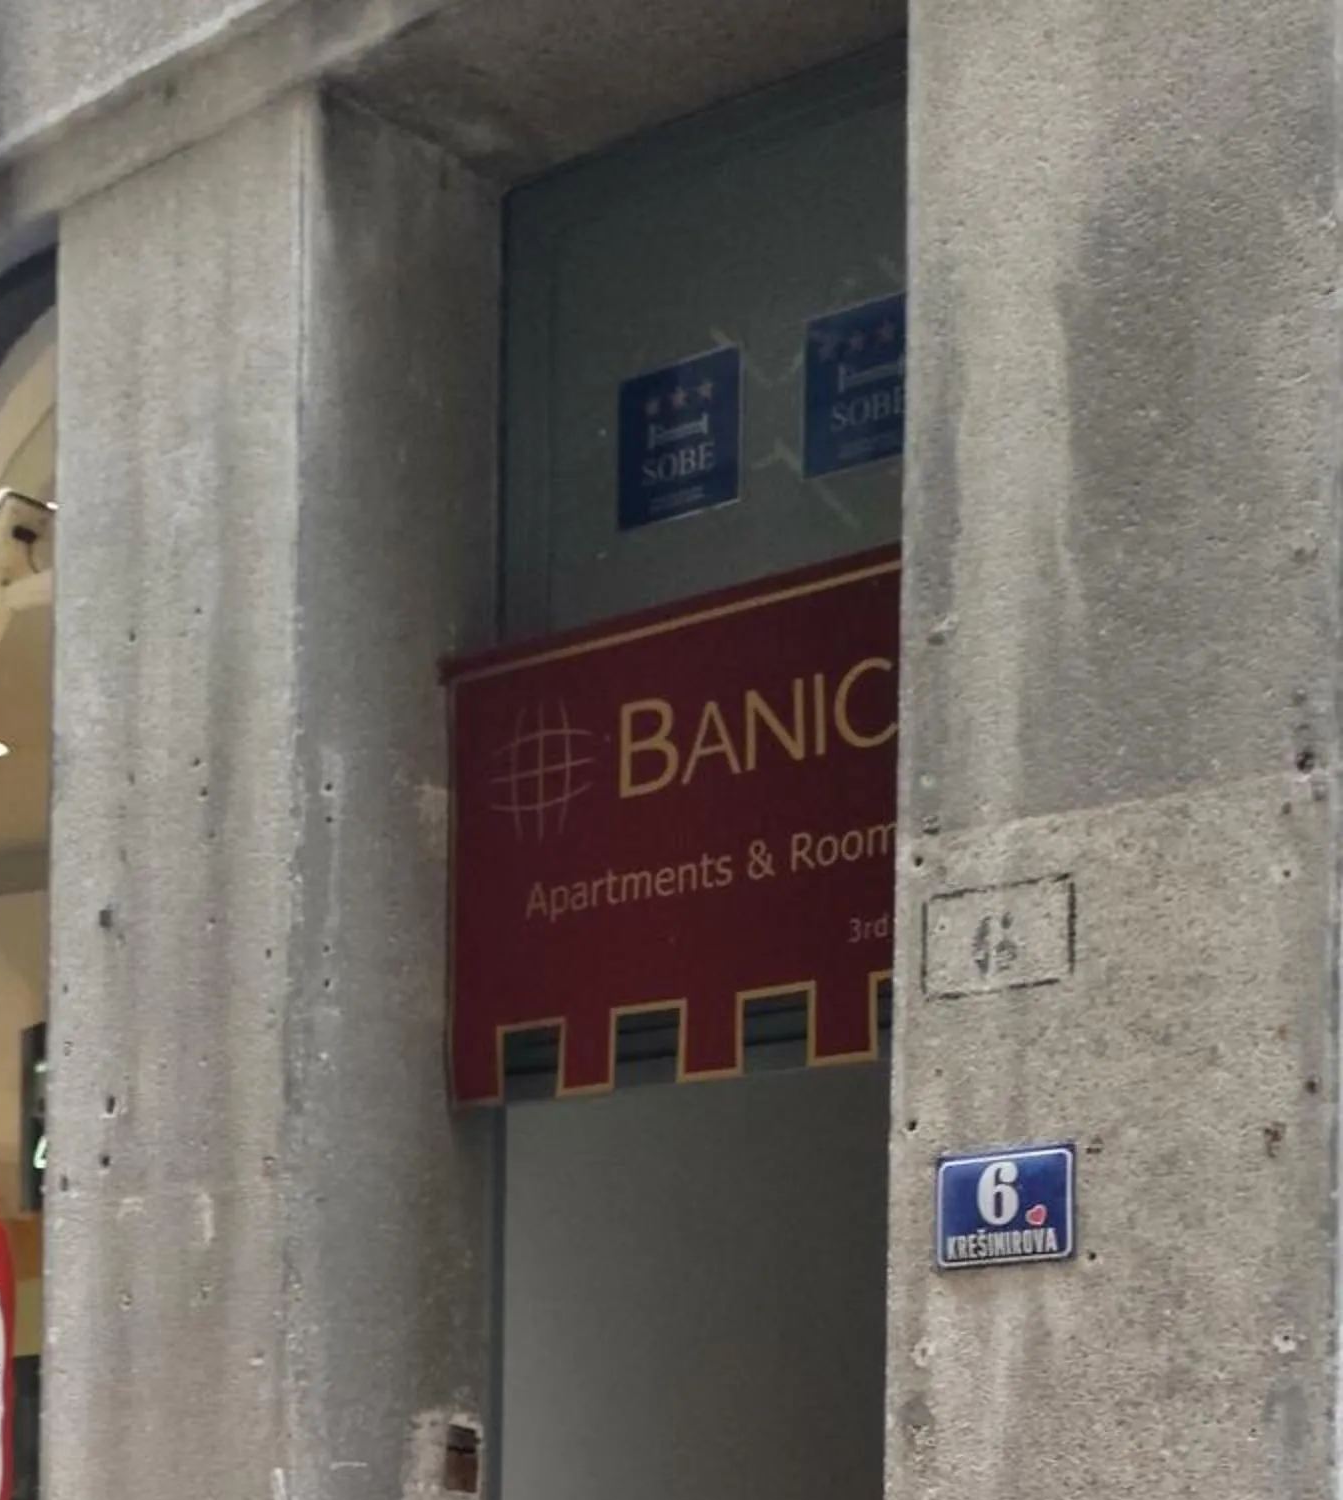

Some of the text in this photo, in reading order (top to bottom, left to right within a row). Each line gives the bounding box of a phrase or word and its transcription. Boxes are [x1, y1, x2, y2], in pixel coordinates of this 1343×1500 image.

[641, 440, 715, 484] SOBE
[619, 657, 898, 798] BANIC
[525, 852, 733, 923] Apartments
[747, 839, 775, 880] &
[848, 912, 889, 943] 3rd
[976, 1161, 1020, 1226] 6
[946, 1227, 1058, 1261] KREŠIMIROVA
